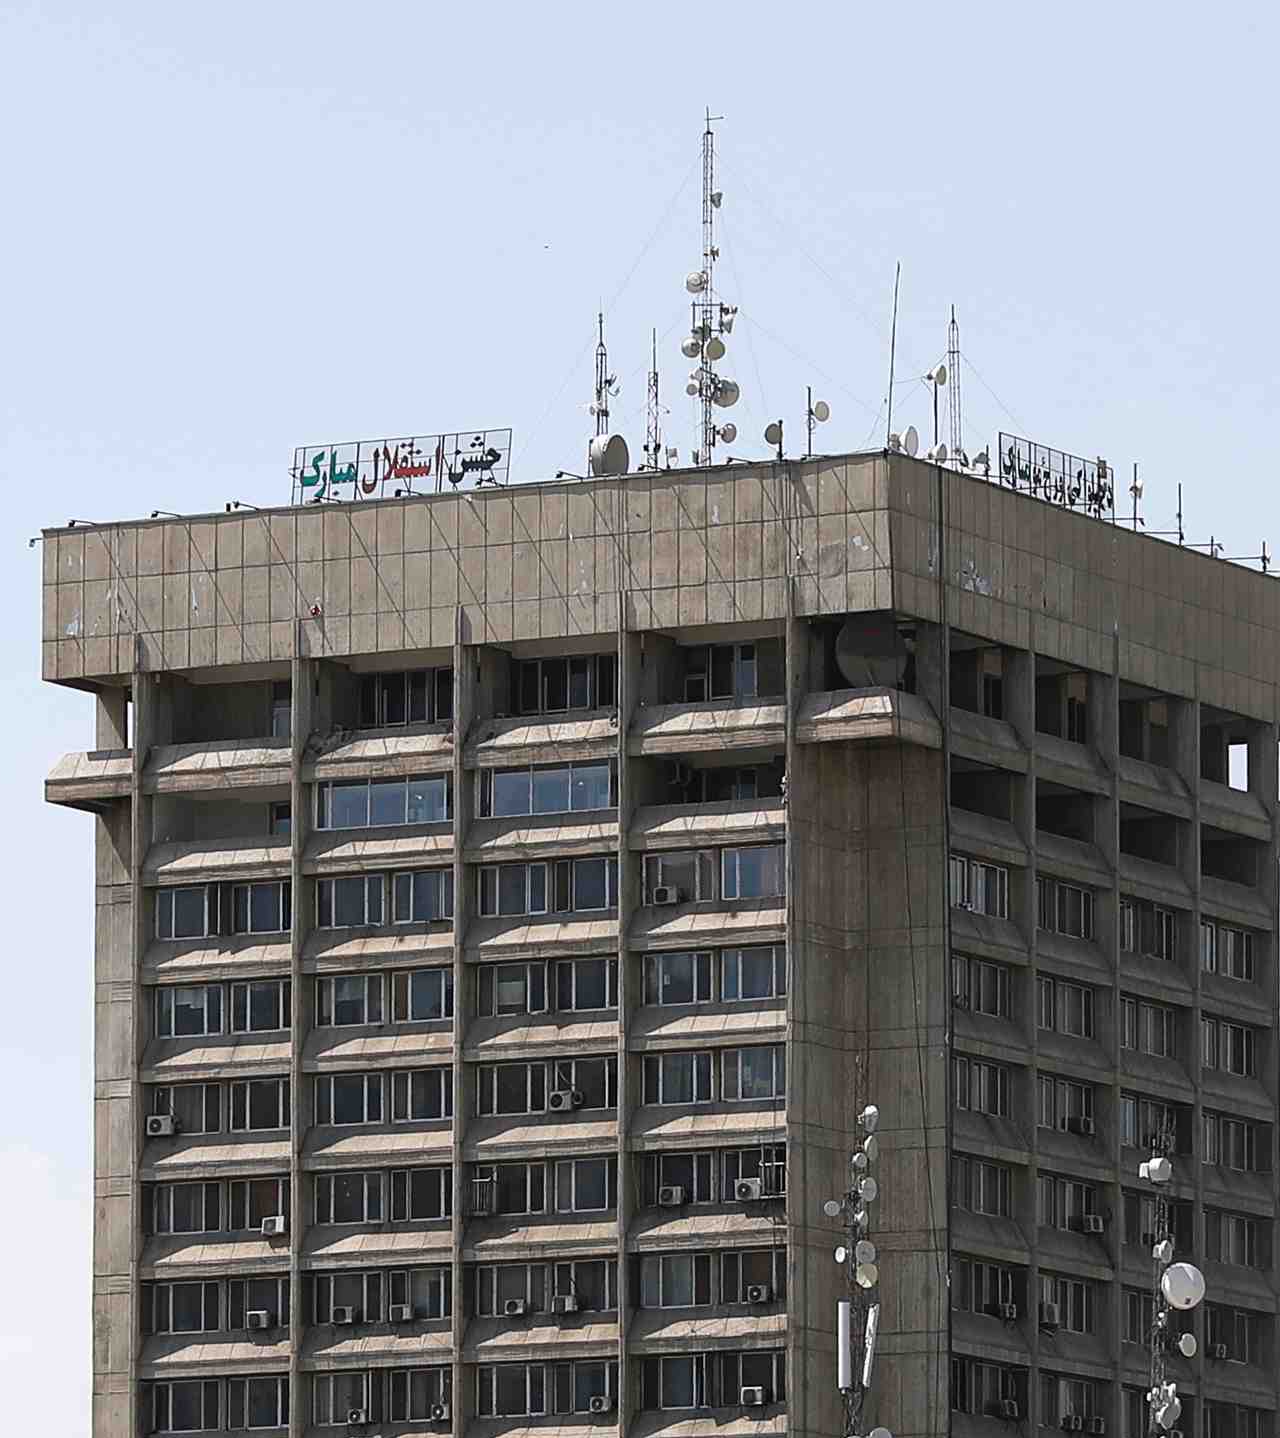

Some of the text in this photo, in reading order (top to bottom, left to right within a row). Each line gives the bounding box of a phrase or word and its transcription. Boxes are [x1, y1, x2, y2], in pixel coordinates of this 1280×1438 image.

[300, 435, 502, 498] جشن استقلال مبارک
